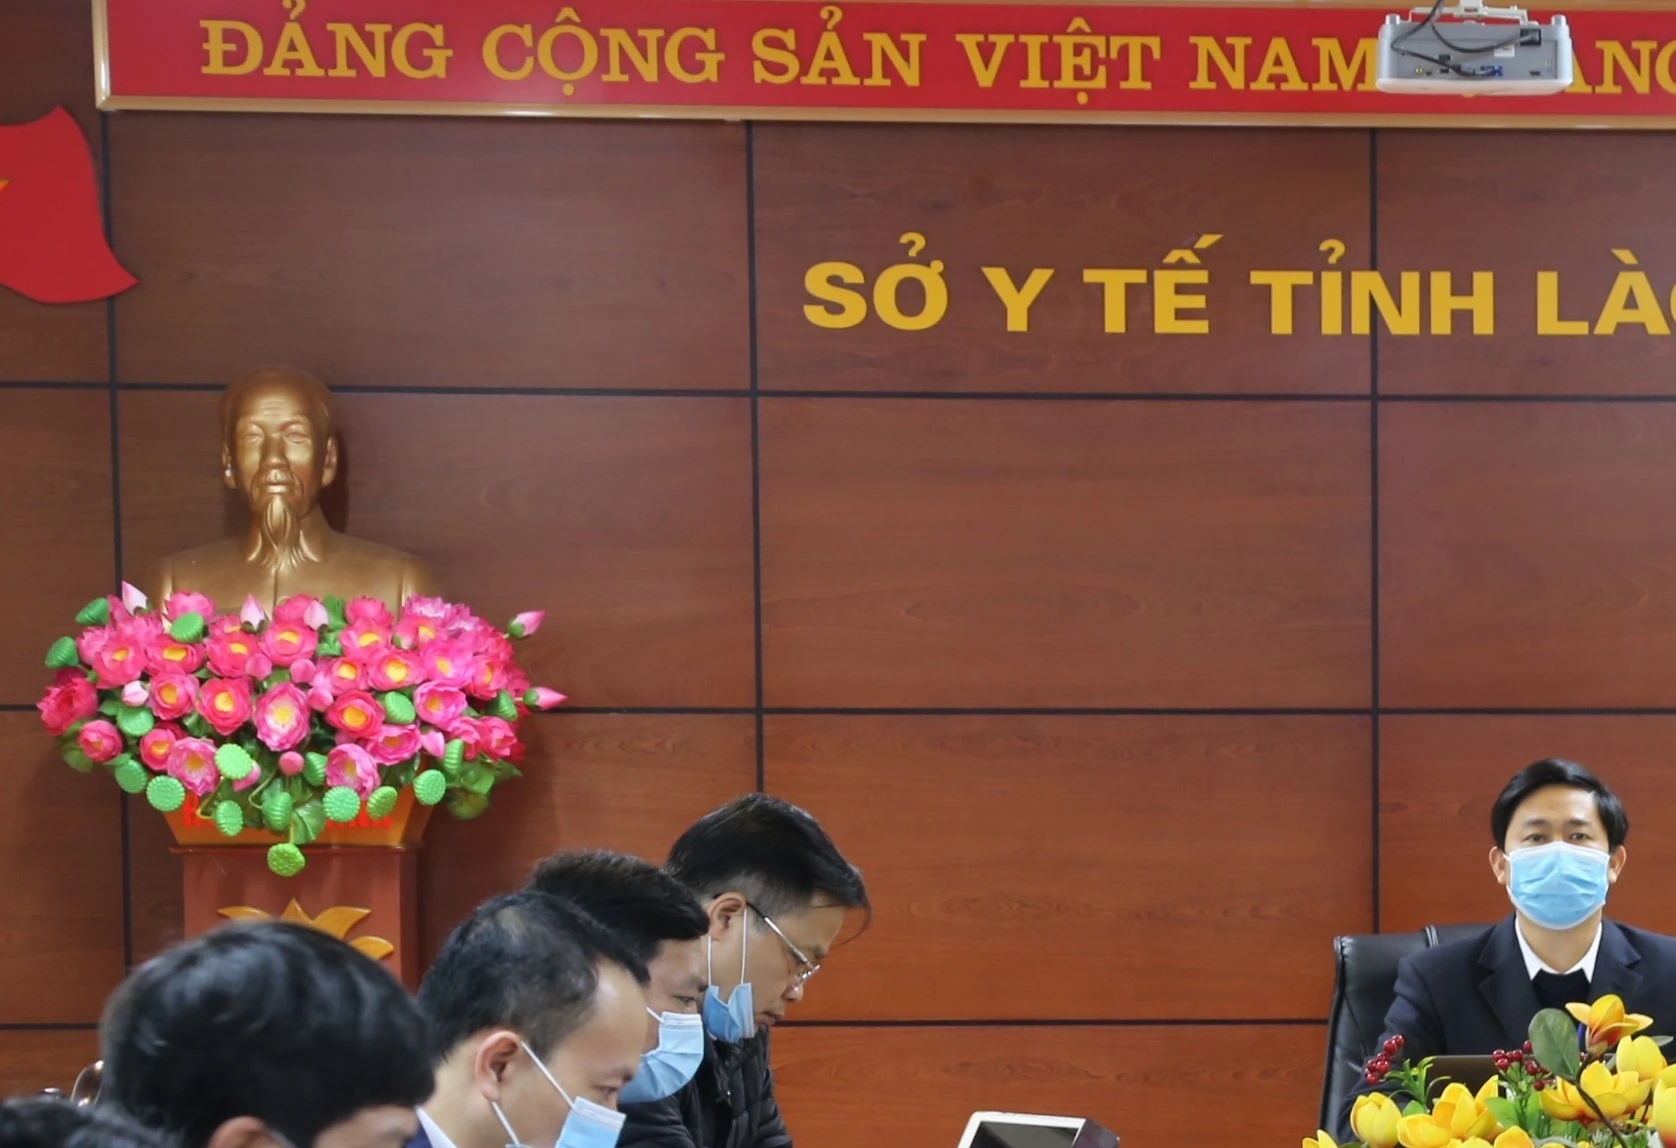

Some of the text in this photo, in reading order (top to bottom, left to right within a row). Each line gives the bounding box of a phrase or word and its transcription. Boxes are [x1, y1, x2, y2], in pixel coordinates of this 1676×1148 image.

[202, 0, 453, 79] ĐẢNG
[483, 7, 725, 96] CỘNG
[752, 5, 927, 87] SẢN
[956, 17, 1162, 104] VIỆT
[1190, 36, 1379, 91] NAM
[802, 231, 948, 331] SỞ
[981, 266, 1055, 333] Y
[1082, 233, 1223, 334] TẾ
[1249, 238, 1495, 336] TỈNH
